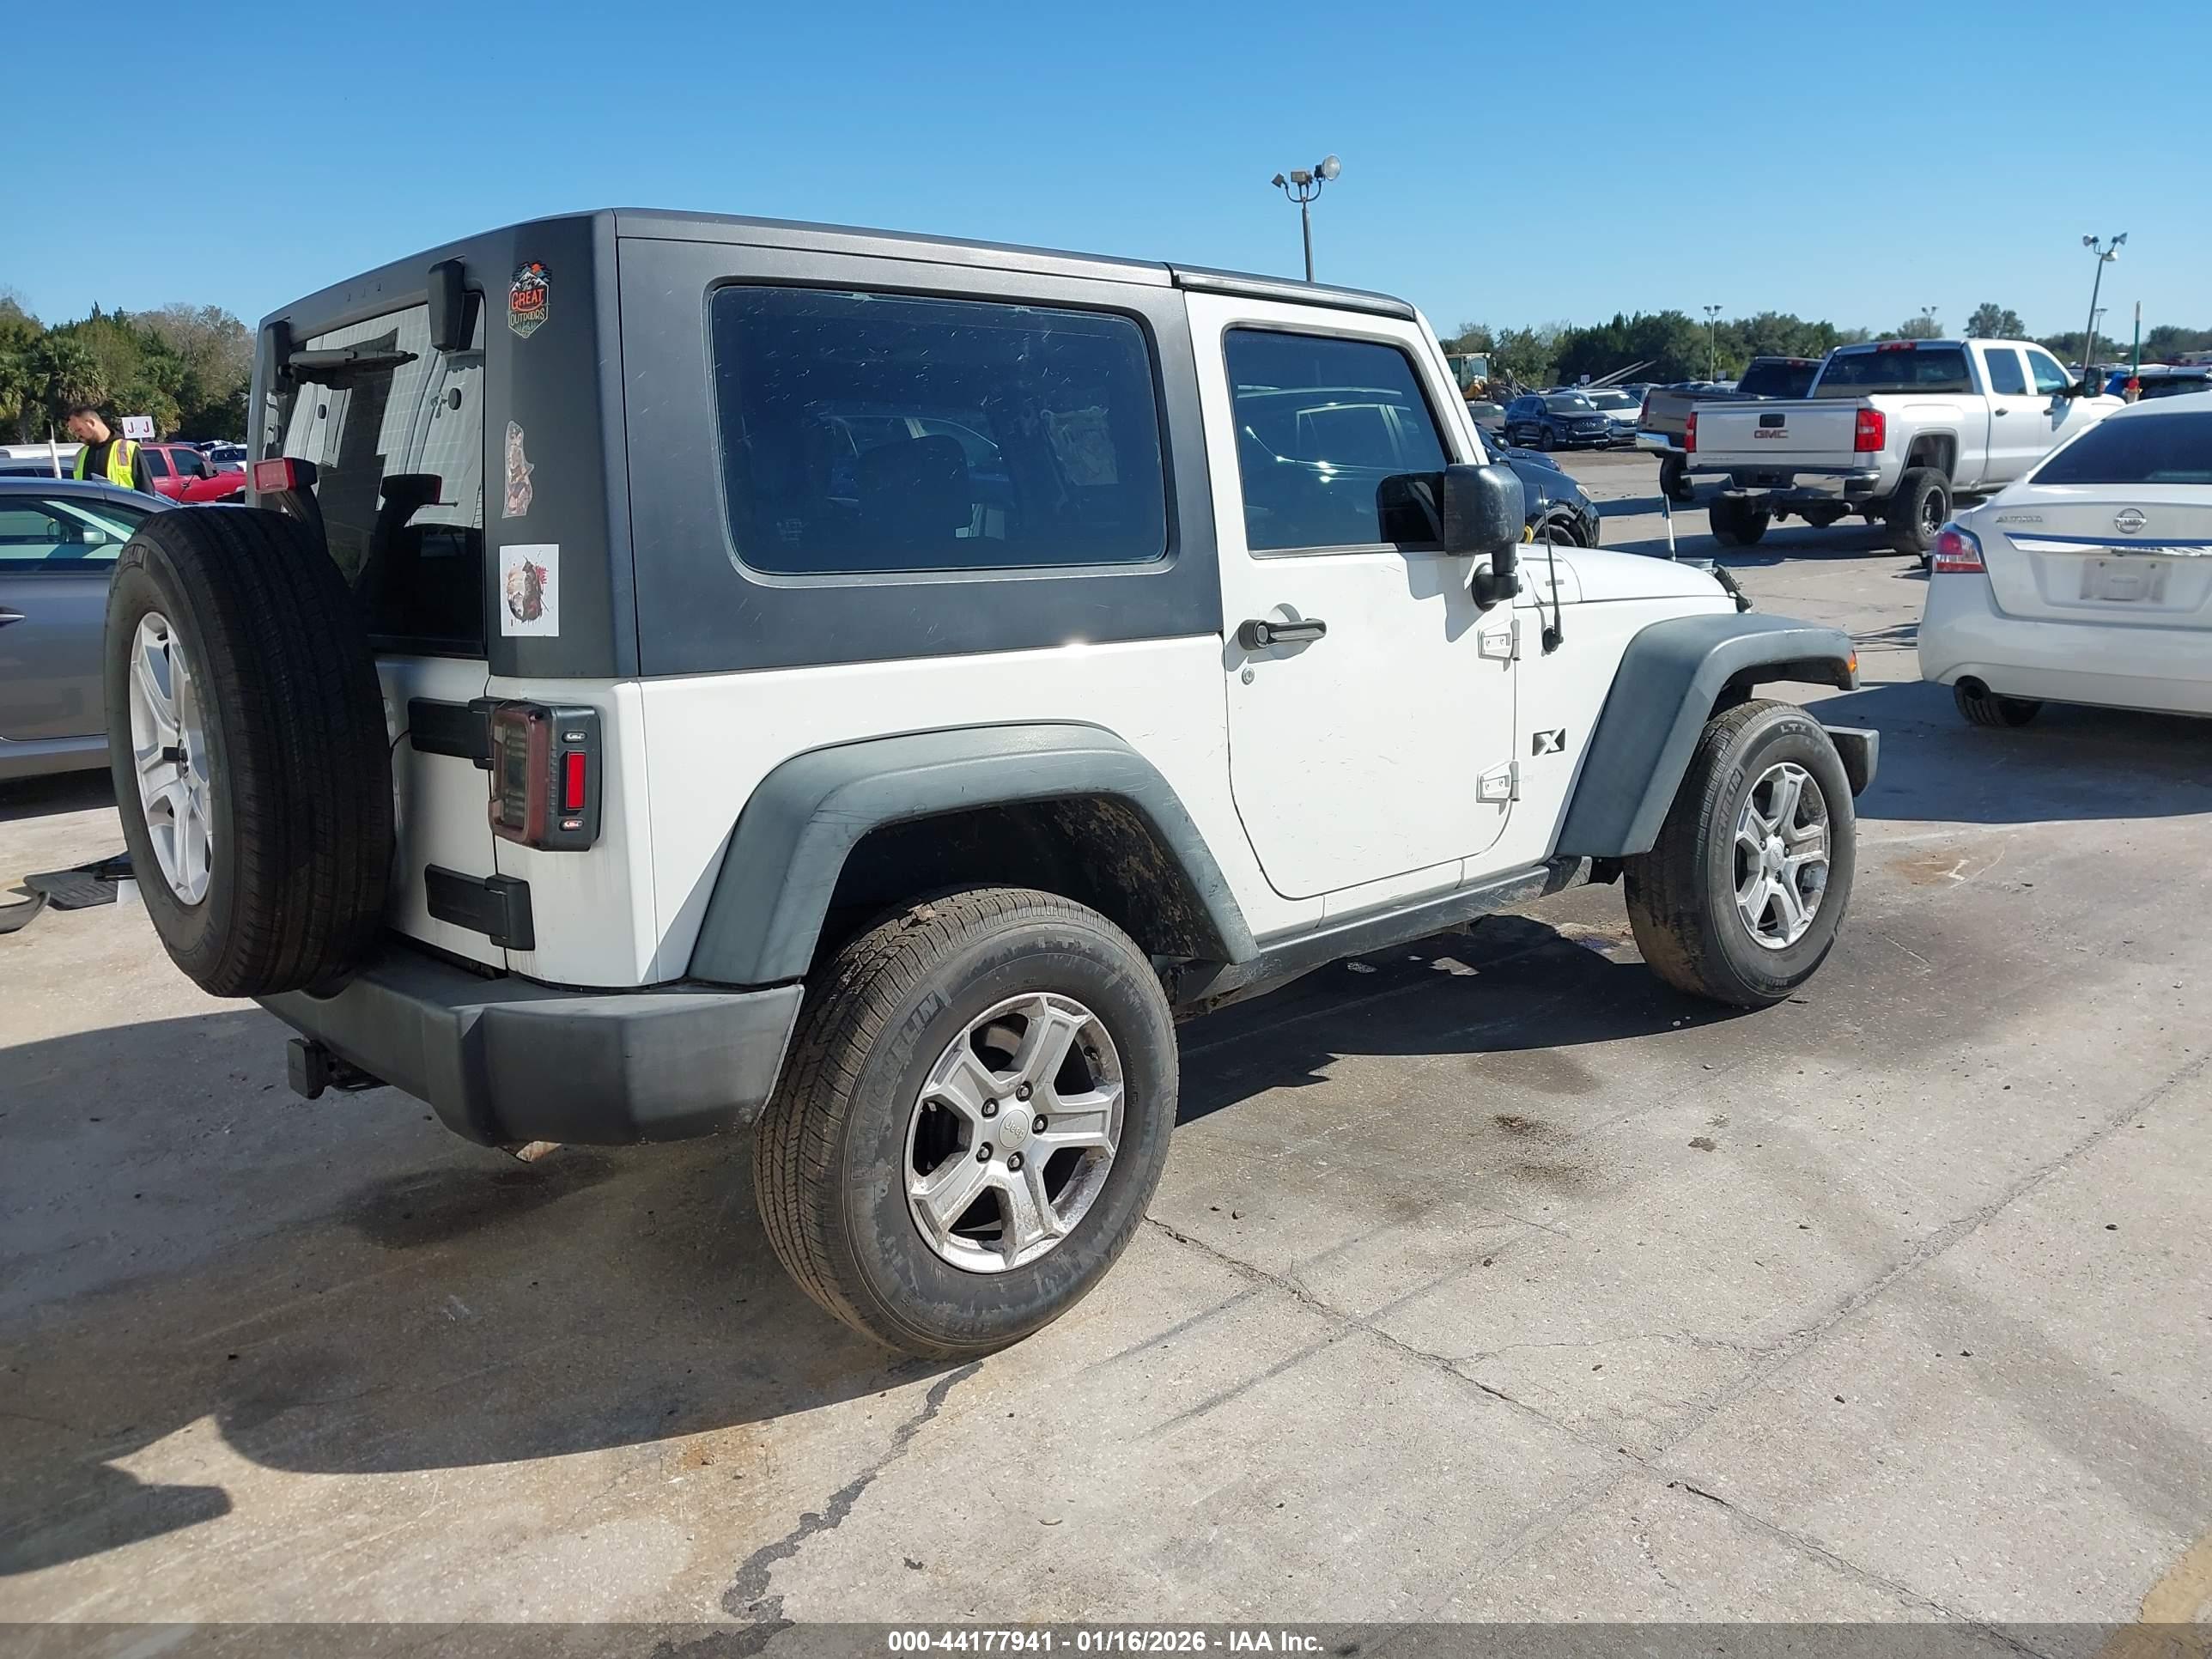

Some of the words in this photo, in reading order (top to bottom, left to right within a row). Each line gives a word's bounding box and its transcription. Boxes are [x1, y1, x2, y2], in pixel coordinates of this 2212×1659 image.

[511, 289, 544, 311] GREAT
[510, 308, 545, 326] OUTDOORS
[128, 421, 134, 433] J
[143, 421, 149, 433] J
[1753, 429, 1789, 439] GMC
[1780, 723, 1808, 734] LTX
[1715, 769, 1743, 866] MICHELIN
[1003, 1119, 1024, 1139] Jeep
